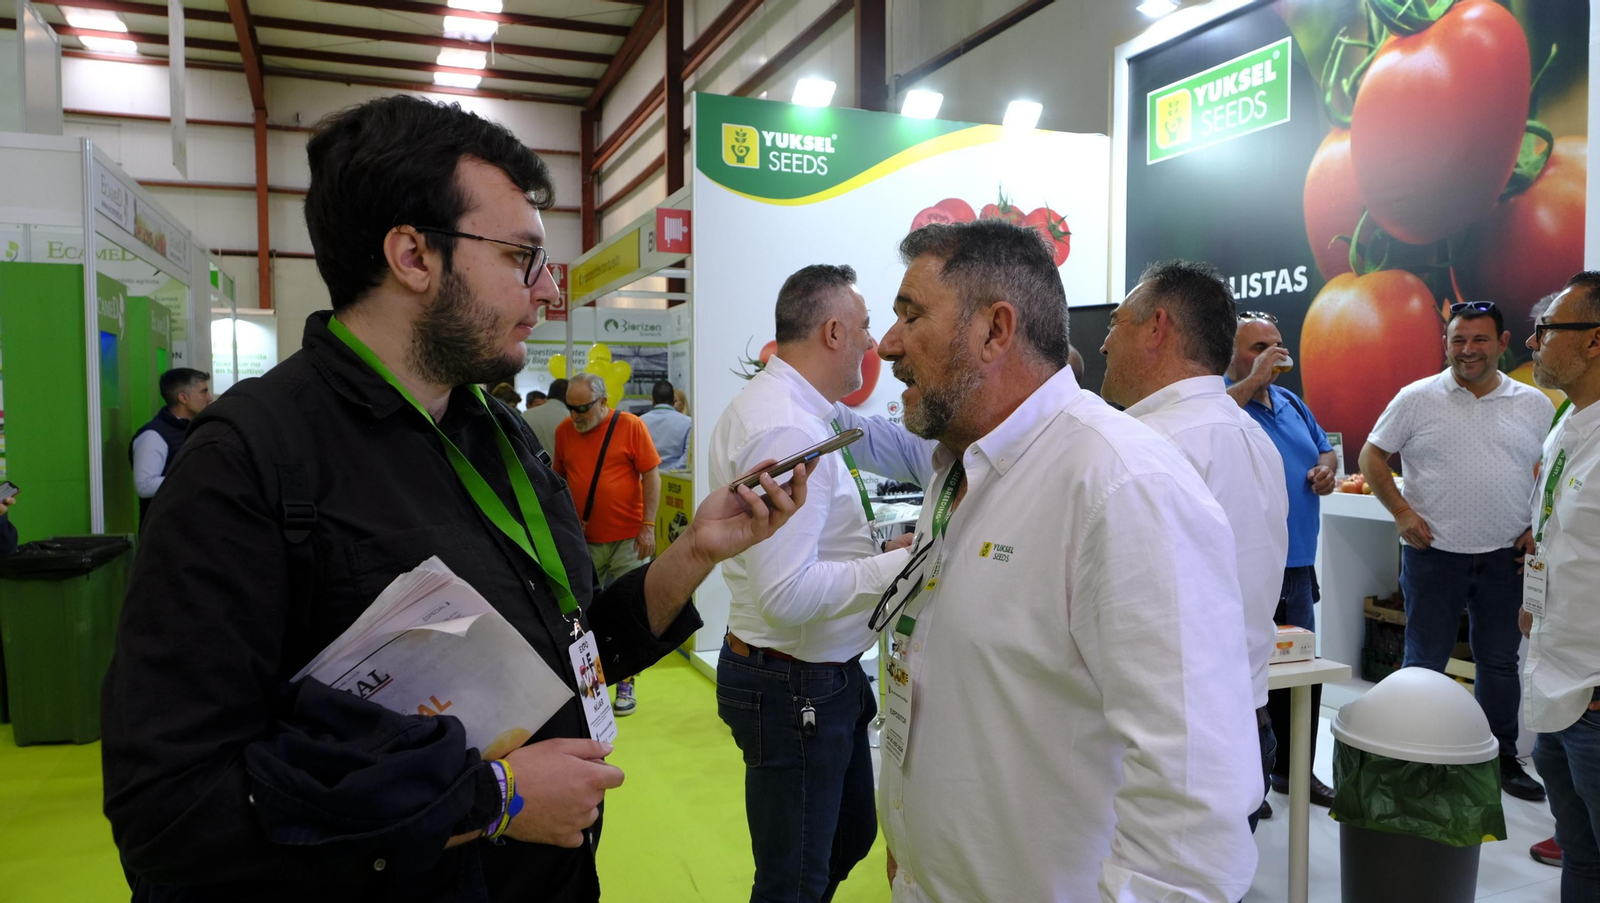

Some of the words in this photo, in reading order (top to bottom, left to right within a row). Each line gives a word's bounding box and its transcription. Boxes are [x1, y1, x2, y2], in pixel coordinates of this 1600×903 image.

[1193, 59, 1277, 107] YUKSEL
[1200, 90, 1268, 138] SEEDS
[761, 130, 836, 153] YUKSEL
[768, 151, 829, 176] SEEDS
[620, 319, 662, 333] Biorizon
[992, 552, 1010, 563] SEEDS
[422, 605, 446, 622] ESPECIAL
[345, 668, 391, 699] AL
